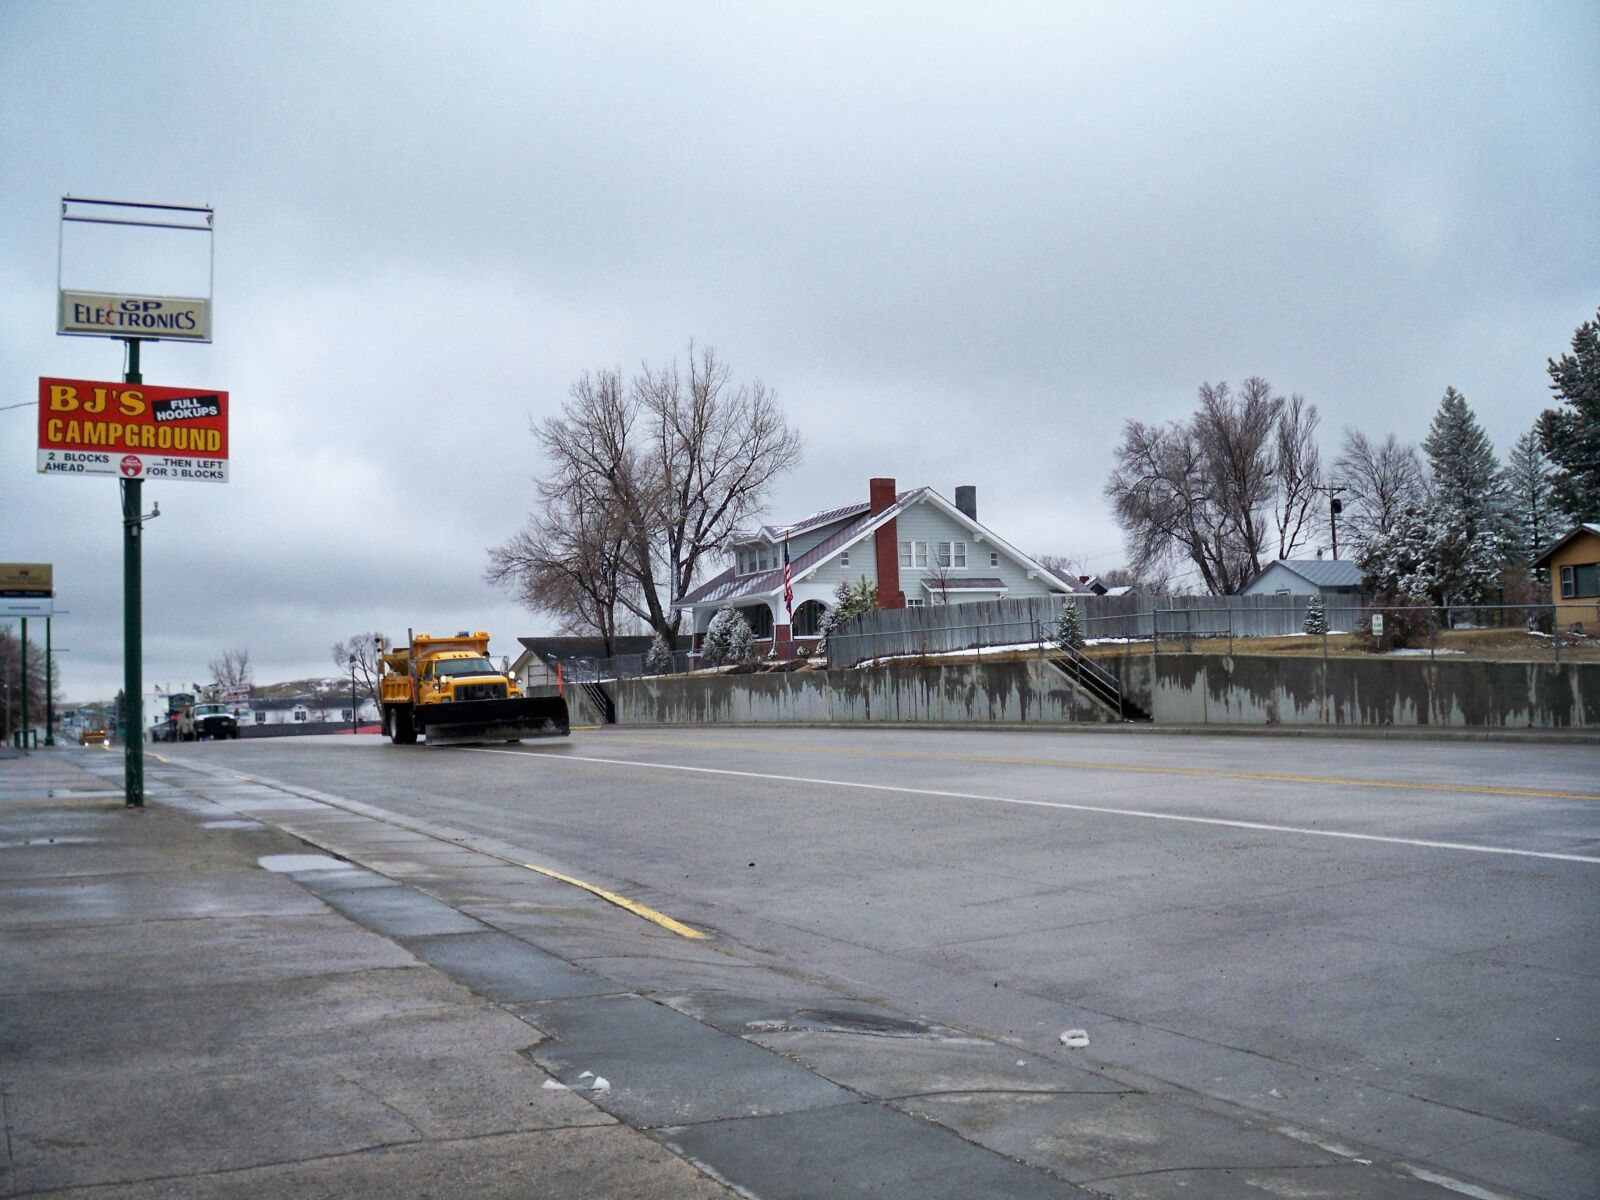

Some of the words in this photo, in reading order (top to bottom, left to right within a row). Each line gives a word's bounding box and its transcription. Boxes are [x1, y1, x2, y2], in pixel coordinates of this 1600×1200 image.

[121, 300, 162, 312] GP
[74, 303, 196, 330] ELECTRONICS
[49, 385, 146, 416] BJ'S
[170, 398, 201, 410] FULL
[156, 406, 218, 421] HOOKUPS
[47, 418, 221, 452] CAMPGROUND
[48, 452, 55, 461] 2
[64, 452, 109, 463] BLOCKS
[197, 460, 223, 469] LEFT
[146, 467, 167, 476] FOR
[171, 469, 178, 477] 3
[181, 469, 224, 479] BLOCKS
